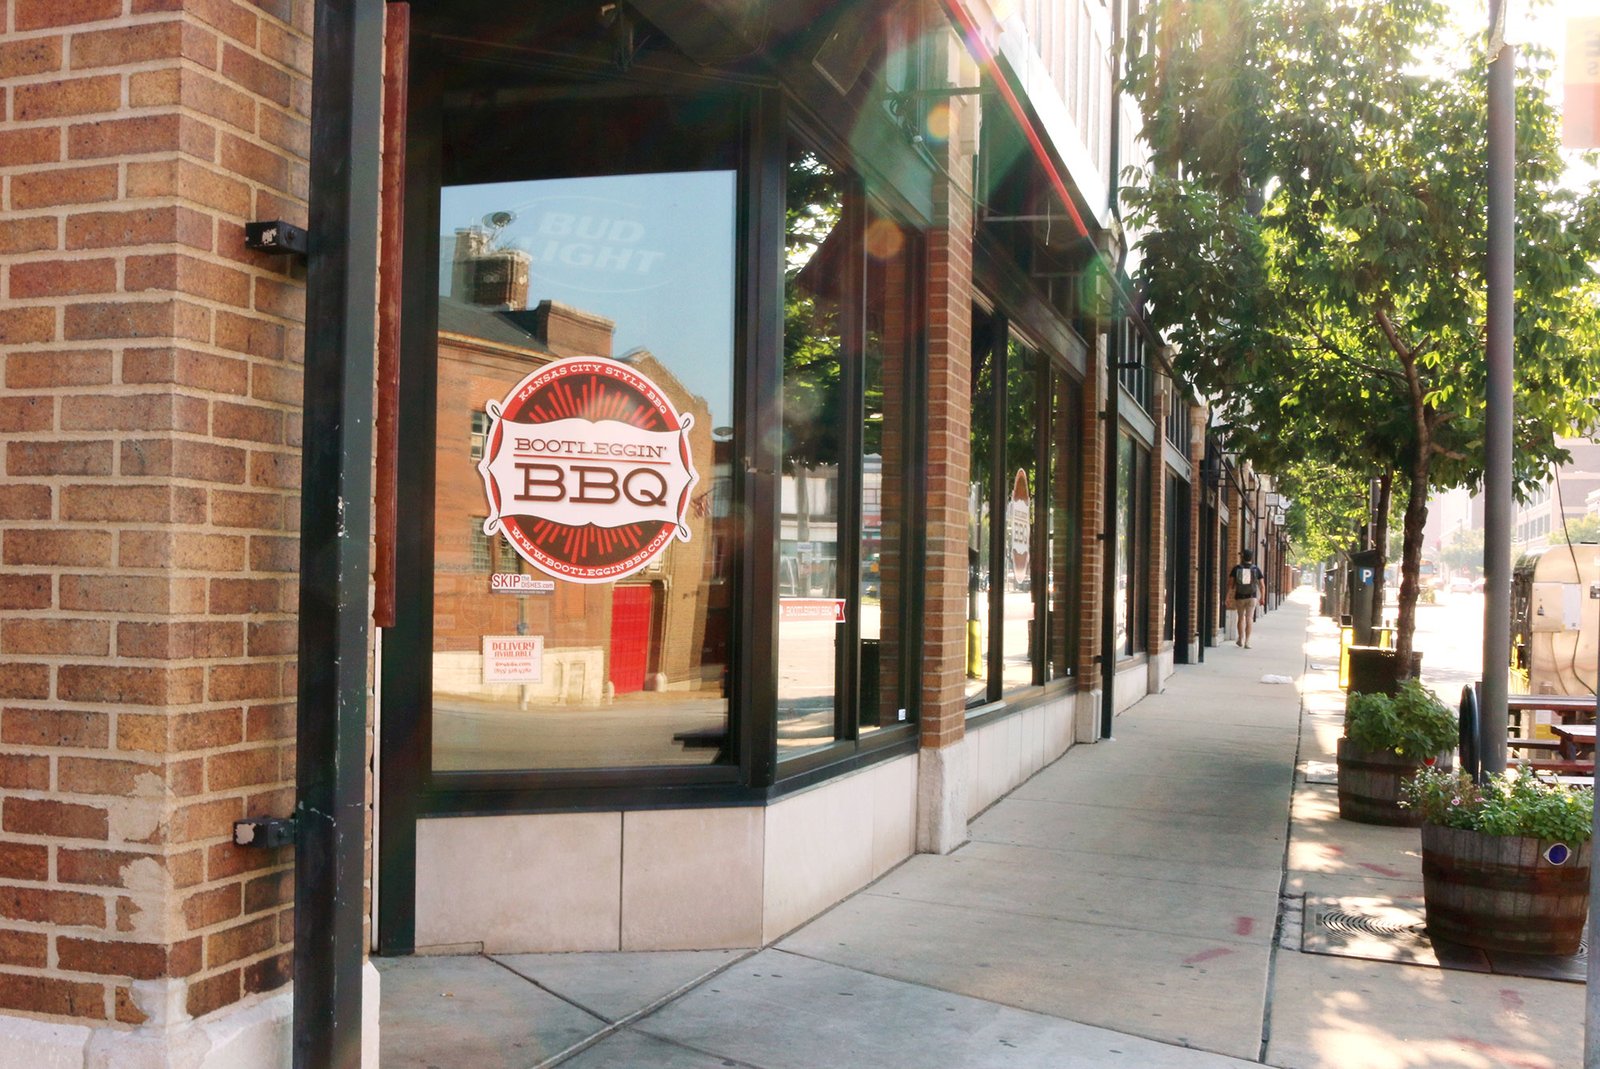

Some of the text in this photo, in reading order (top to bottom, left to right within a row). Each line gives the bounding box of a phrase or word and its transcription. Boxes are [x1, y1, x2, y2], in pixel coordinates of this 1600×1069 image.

[538, 211, 645, 242] BUD
[518, 364, 667, 414] KANSAS CITY STYLE BBQ
[514, 437, 667, 458] BOOTLEGGIN'
[514, 462, 668, 507] BBQ
[511, 526, 669, 576] WWW.BOOTLEGGINBBQ.COM
[492, 574, 521, 588] SKIP
[1363, 570, 1372, 582] P
[492, 641, 535, 651] DELIVERY
